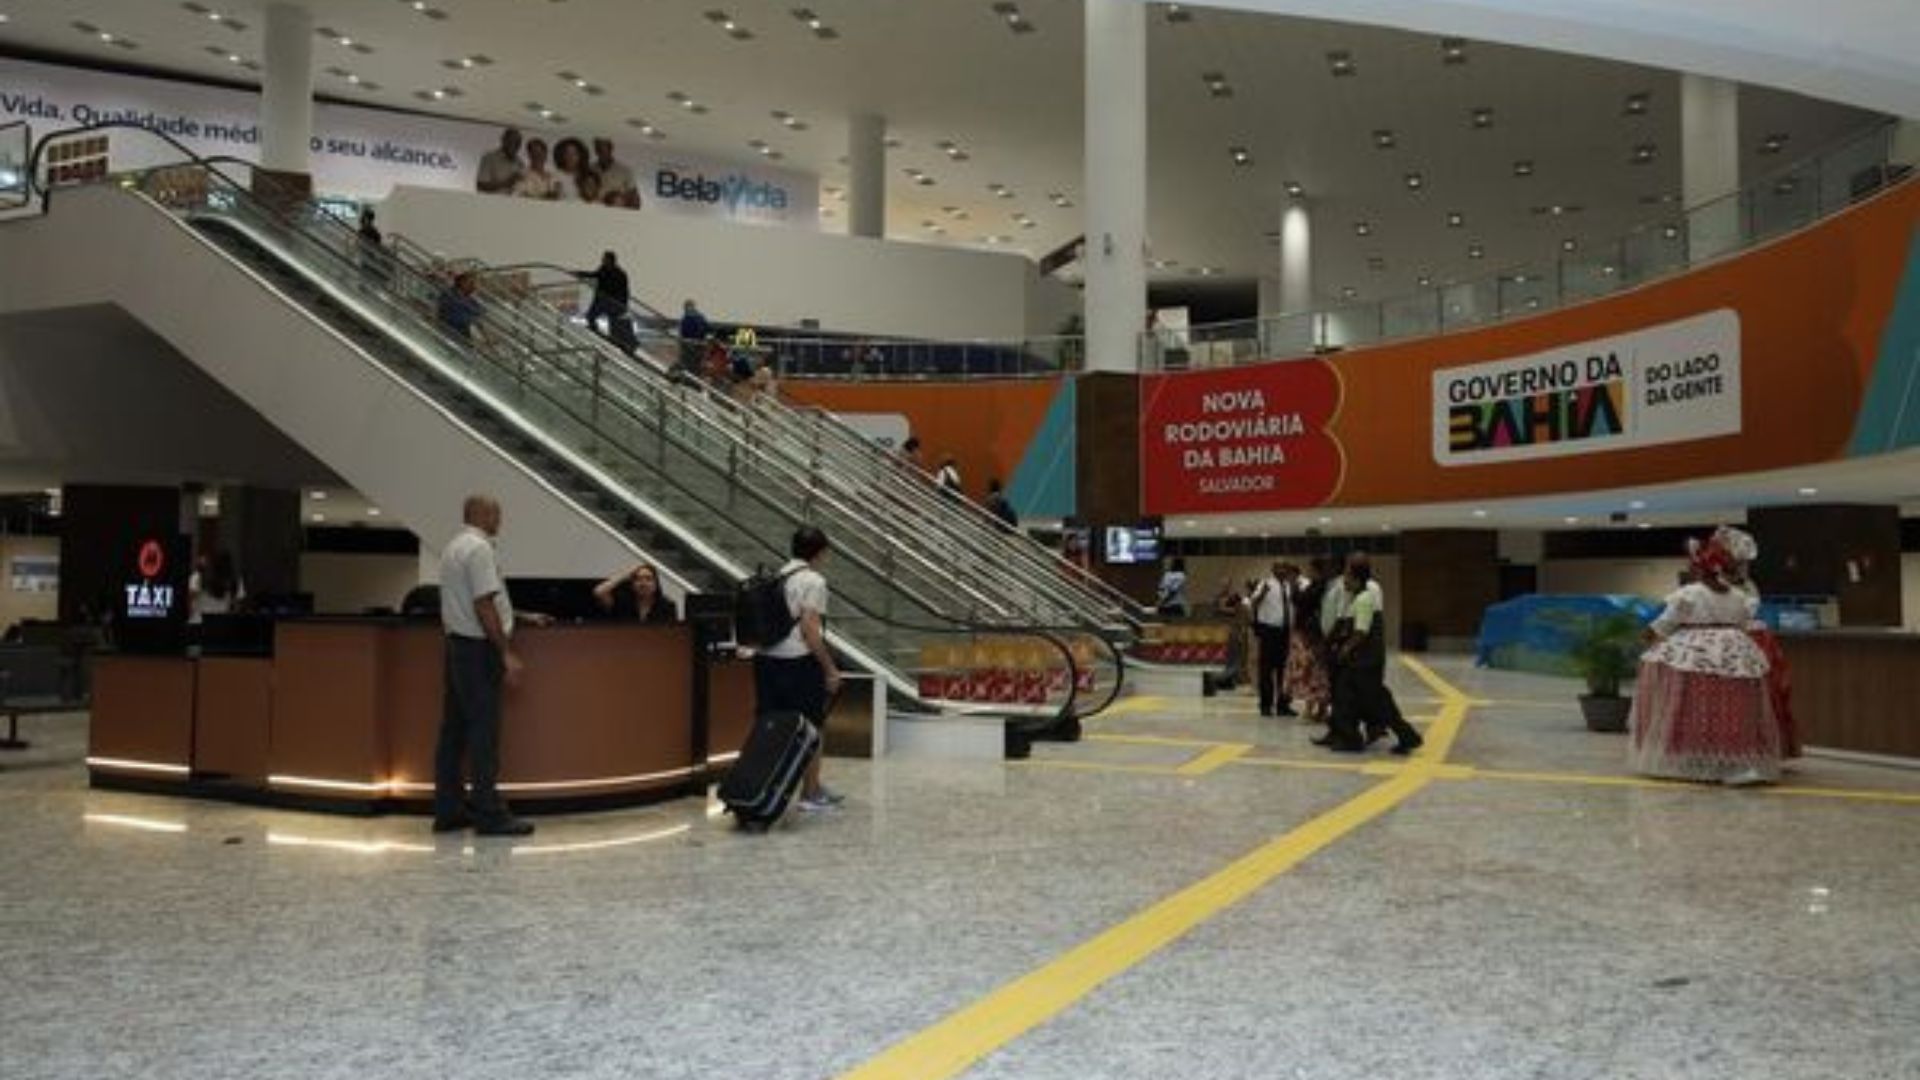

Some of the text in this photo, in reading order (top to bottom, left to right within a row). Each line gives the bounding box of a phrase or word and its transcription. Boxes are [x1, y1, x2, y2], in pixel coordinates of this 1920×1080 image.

[327, 140, 366, 157] seu
[371, 141, 458, 169] alcance.
[1449, 353, 1623, 403] GOVERNO DA
[1645, 354, 1720, 383] DO LADO
[1202, 388, 1266, 413] NOVA
[1646, 375, 1724, 405] DA GENTE
[1163, 411, 1305, 444] RODOVIÁRIA
[1183, 443, 1286, 469] DA BAHIA
[1199, 475, 1276, 494] SALVADOR
[125, 577, 173, 606] TÁXI
